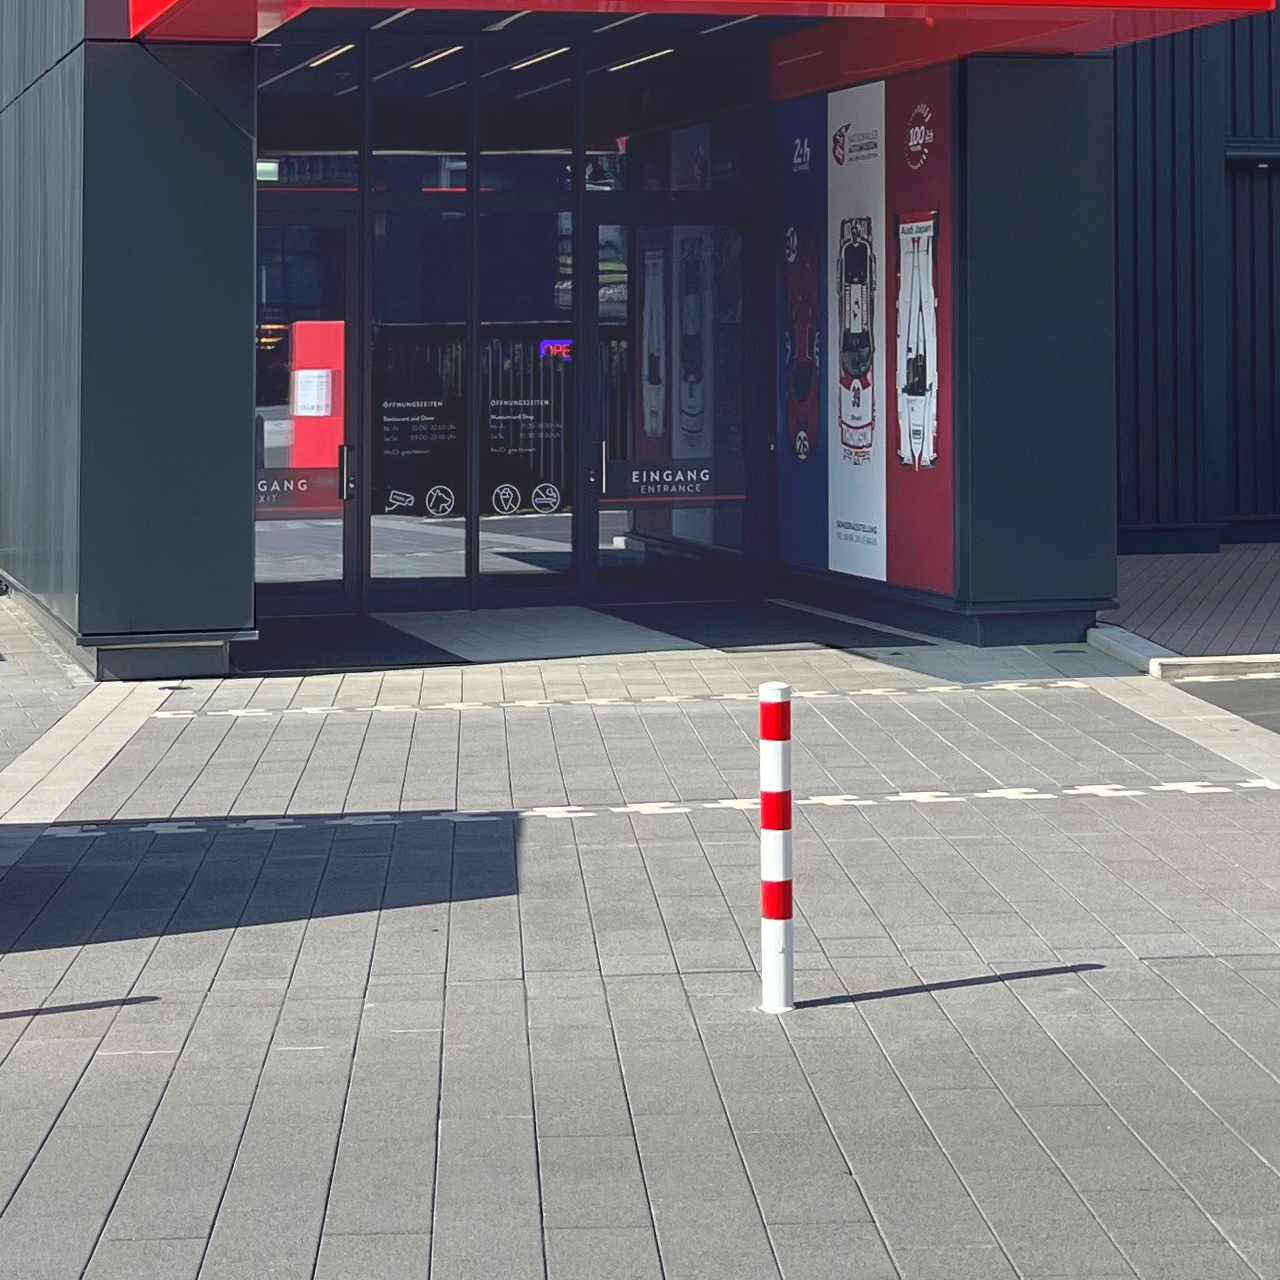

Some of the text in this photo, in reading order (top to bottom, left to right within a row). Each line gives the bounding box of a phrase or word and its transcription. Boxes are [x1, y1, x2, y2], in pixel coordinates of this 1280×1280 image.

[908, 125, 925, 147] 100
[544, 343, 571, 358] OPE
[631, 469, 710, 483] EINGANG
[257, 479, 309, 492] GANG
[640, 483, 701, 494] ENTRANCE
